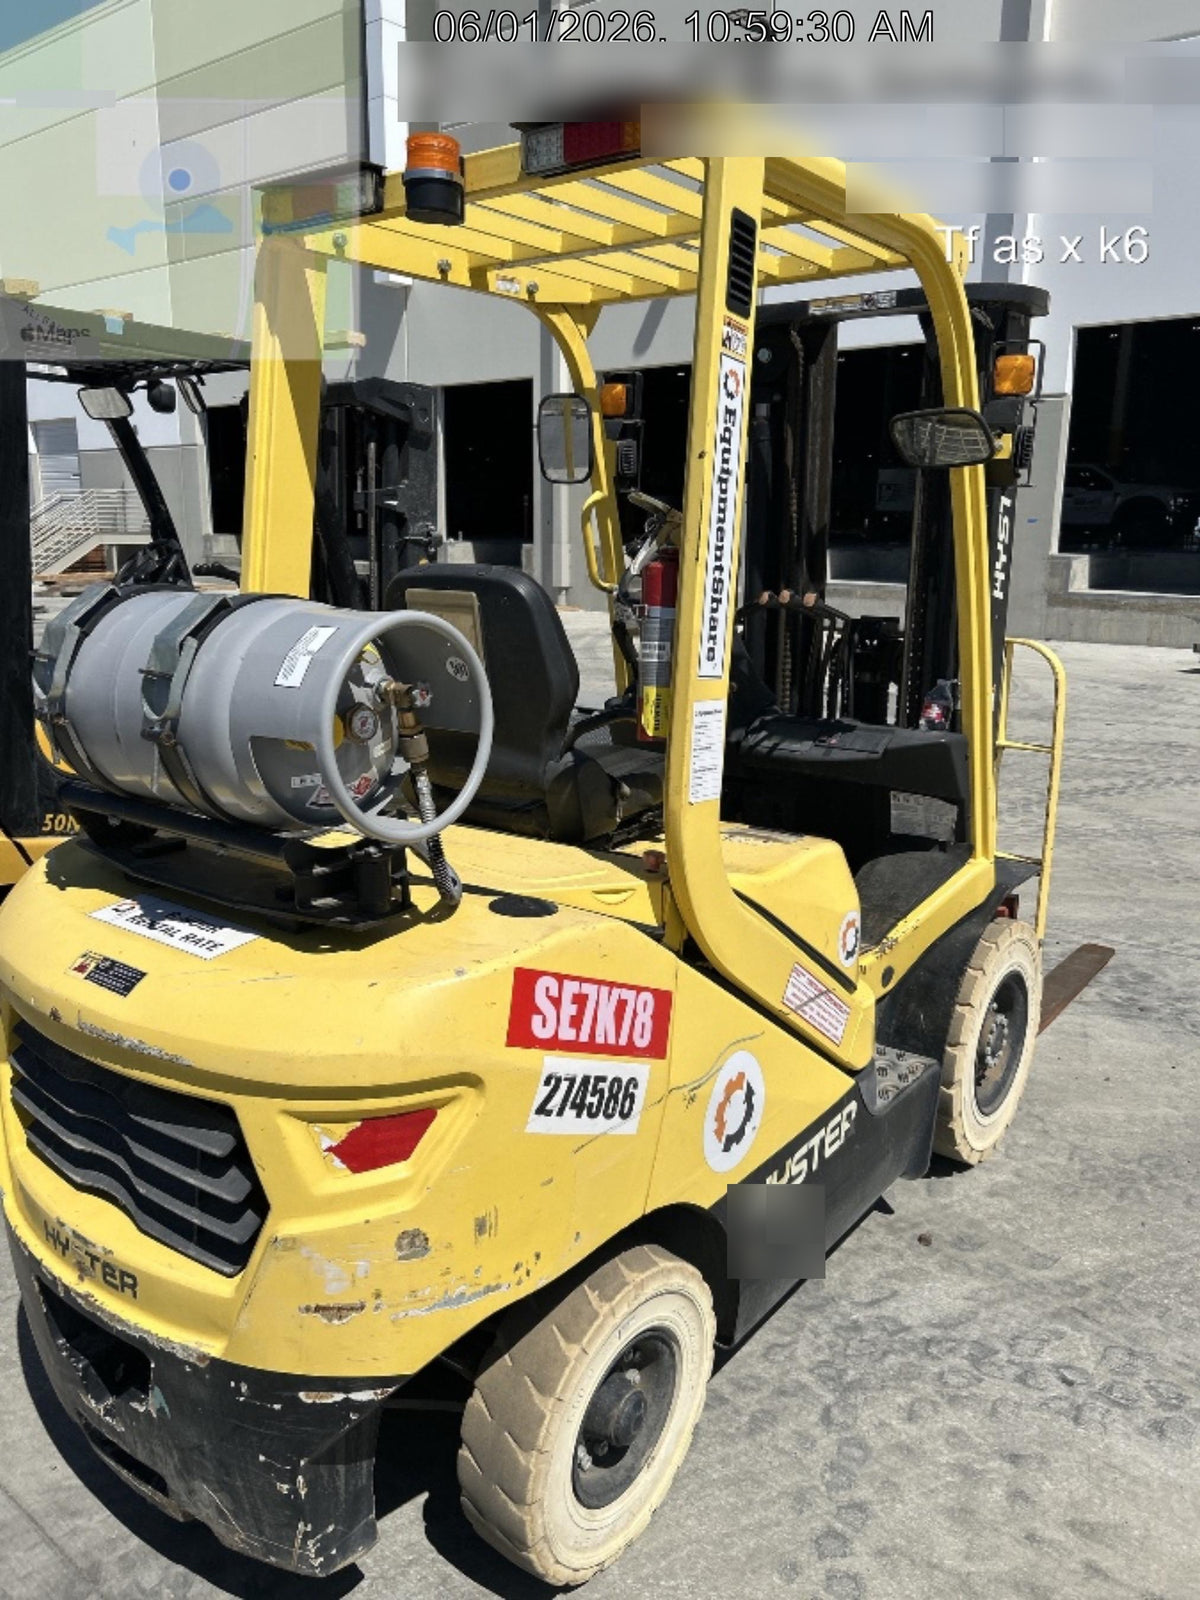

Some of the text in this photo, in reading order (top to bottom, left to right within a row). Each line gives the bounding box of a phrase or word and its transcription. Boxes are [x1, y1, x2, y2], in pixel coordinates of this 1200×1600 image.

[706, 405, 737, 662] EquipmentShare
[531, 975, 655, 1048] SE7K78
[534, 1072, 639, 1121] 274586
[43, 1218, 138, 1300] HYTER
